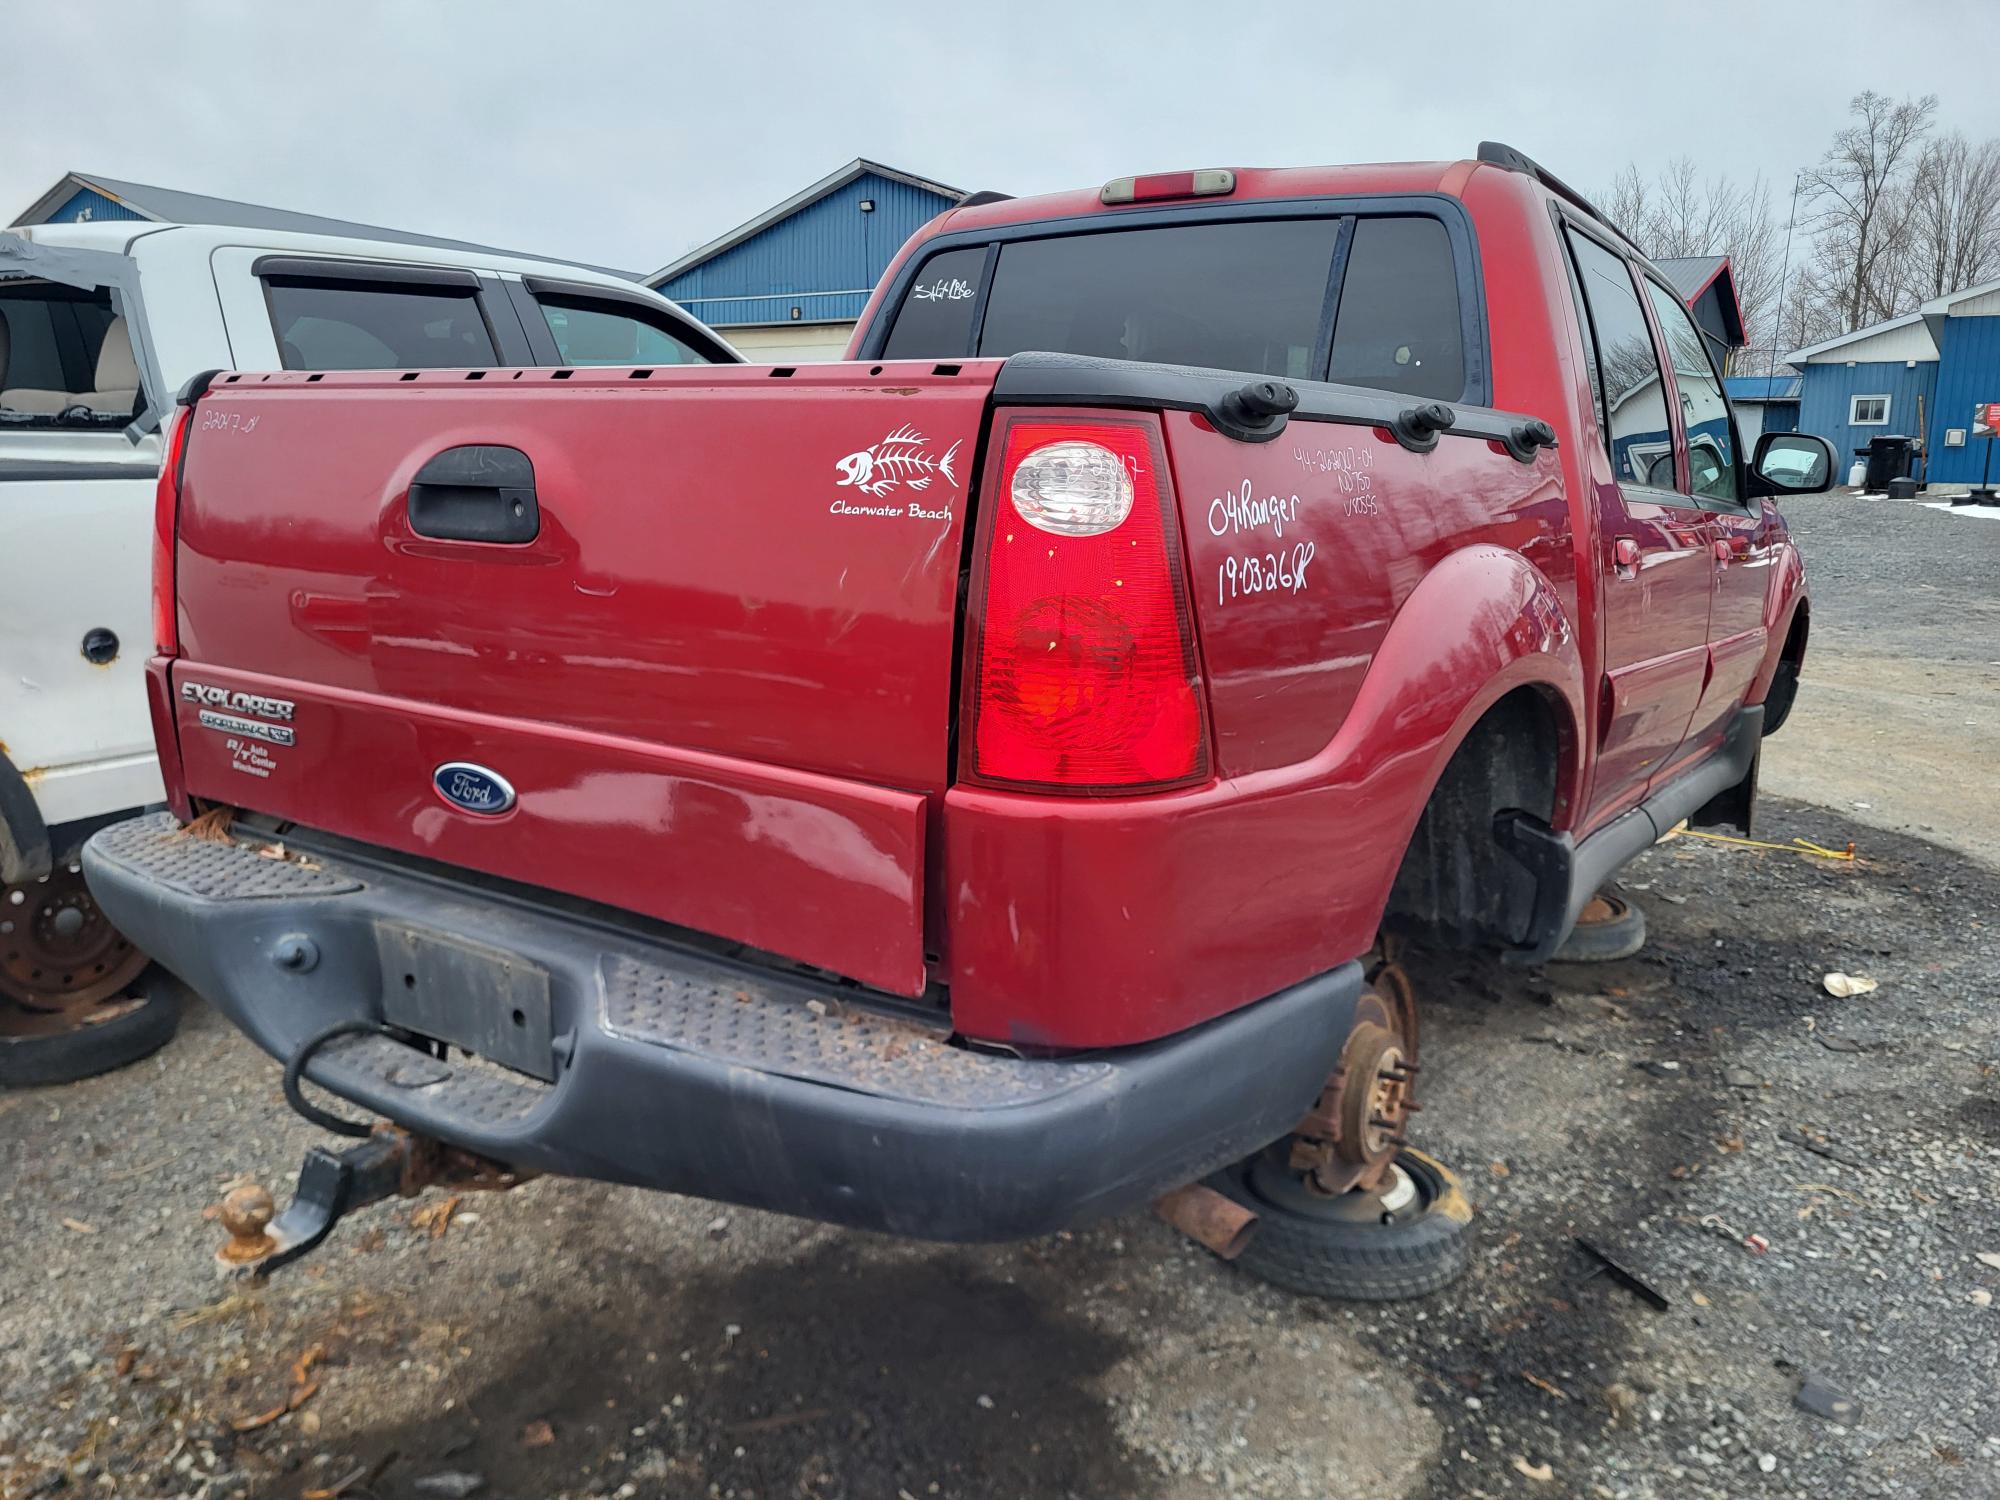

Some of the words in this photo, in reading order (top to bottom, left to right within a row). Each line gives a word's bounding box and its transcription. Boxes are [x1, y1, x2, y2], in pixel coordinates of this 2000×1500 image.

[829, 500, 903, 517] Clearwater
[908, 503, 952, 521] Beach
[181, 681, 296, 720] EXPLORER
[450, 772, 492, 804] Ford
